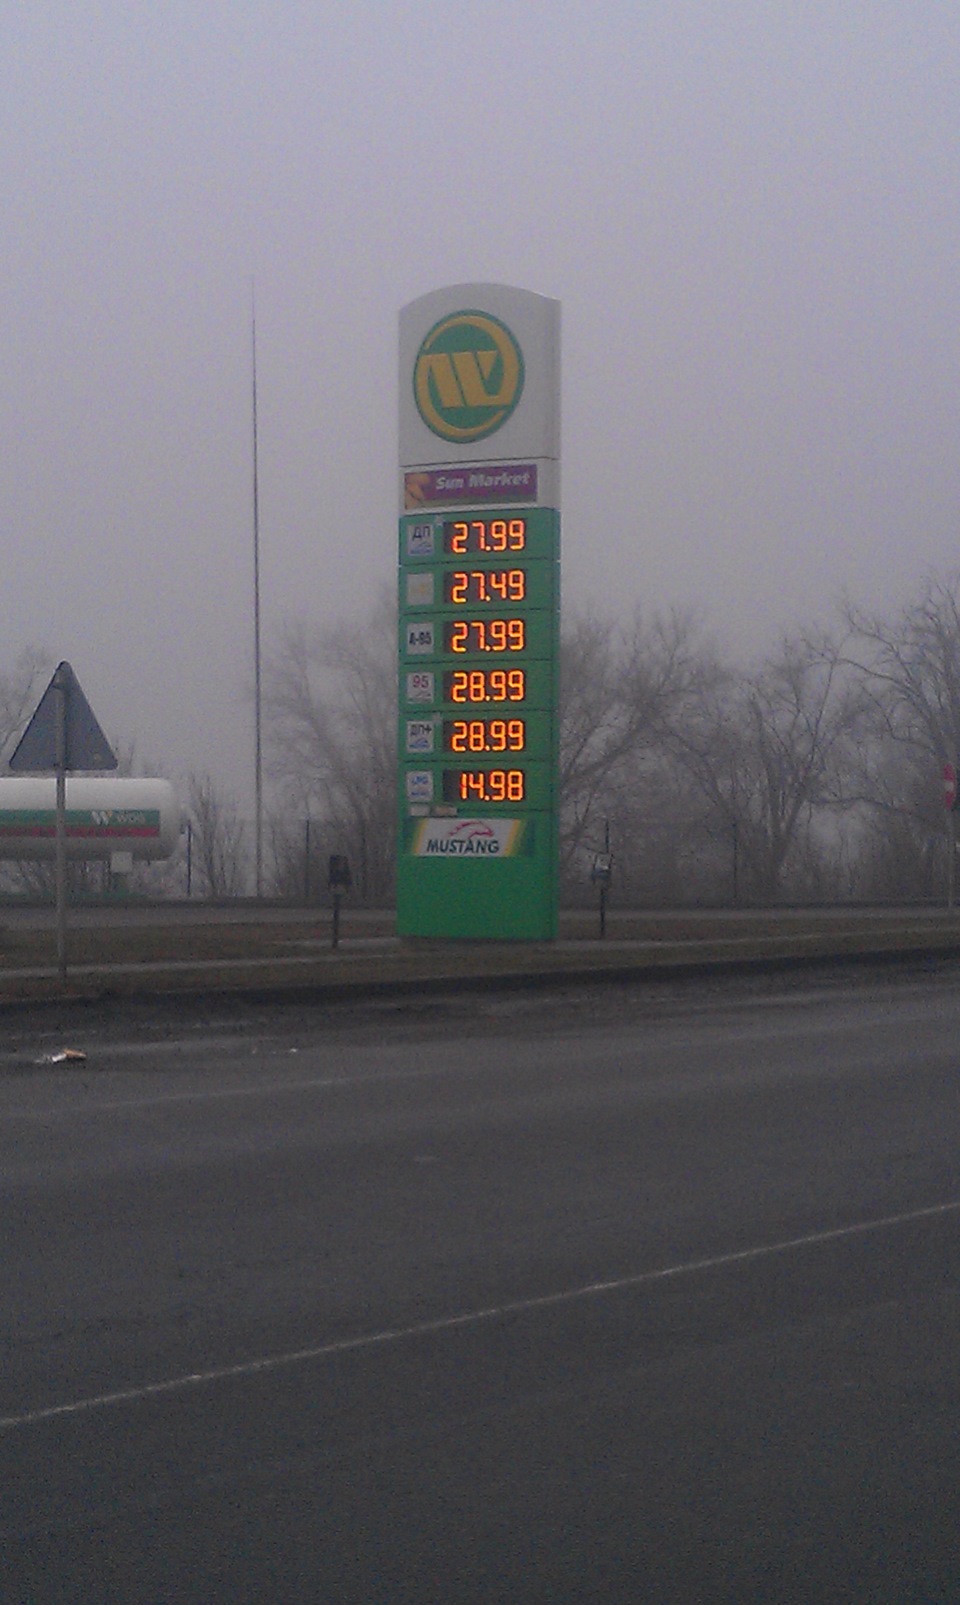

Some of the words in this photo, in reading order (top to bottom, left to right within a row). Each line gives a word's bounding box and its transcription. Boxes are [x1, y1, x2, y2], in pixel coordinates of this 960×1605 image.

[435, 476, 464, 491] Sun
[469, 472, 531, 489] Market
[451, 519, 526, 554] 27.99
[451, 569, 526, 604] 27.49
[451, 619, 525, 654] 27.99
[412, 675, 429, 688] 95
[451, 669, 525, 703] 28.99
[450, 720, 525, 753] 28.99
[460, 770, 524, 802] 14.98
[426, 838, 500, 854] MUSTANG
